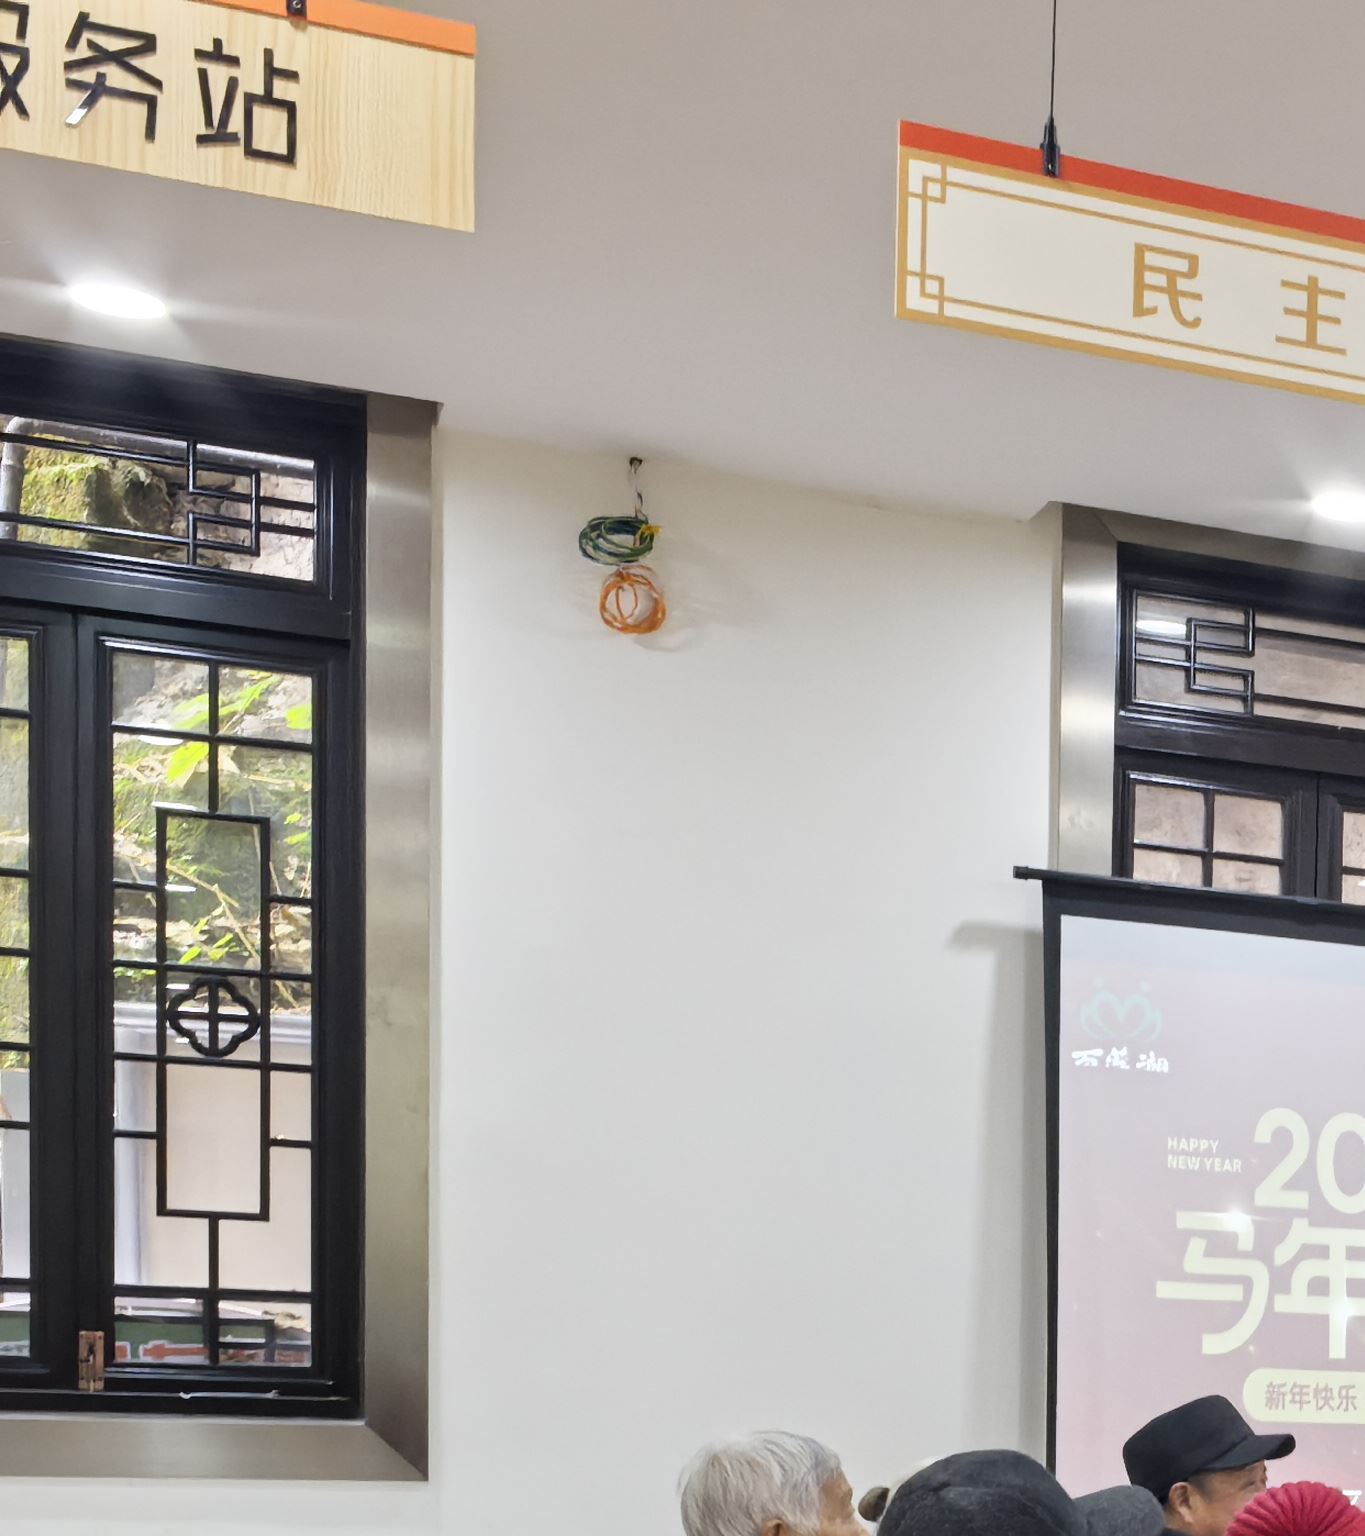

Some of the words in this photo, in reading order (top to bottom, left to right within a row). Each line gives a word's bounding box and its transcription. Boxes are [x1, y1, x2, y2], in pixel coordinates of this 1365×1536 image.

[1167, 1136, 1220, 1153] HAPPY
[1167, 1155, 1201, 1170] NEW
[1204, 1157, 1243, 1173] YEAR
